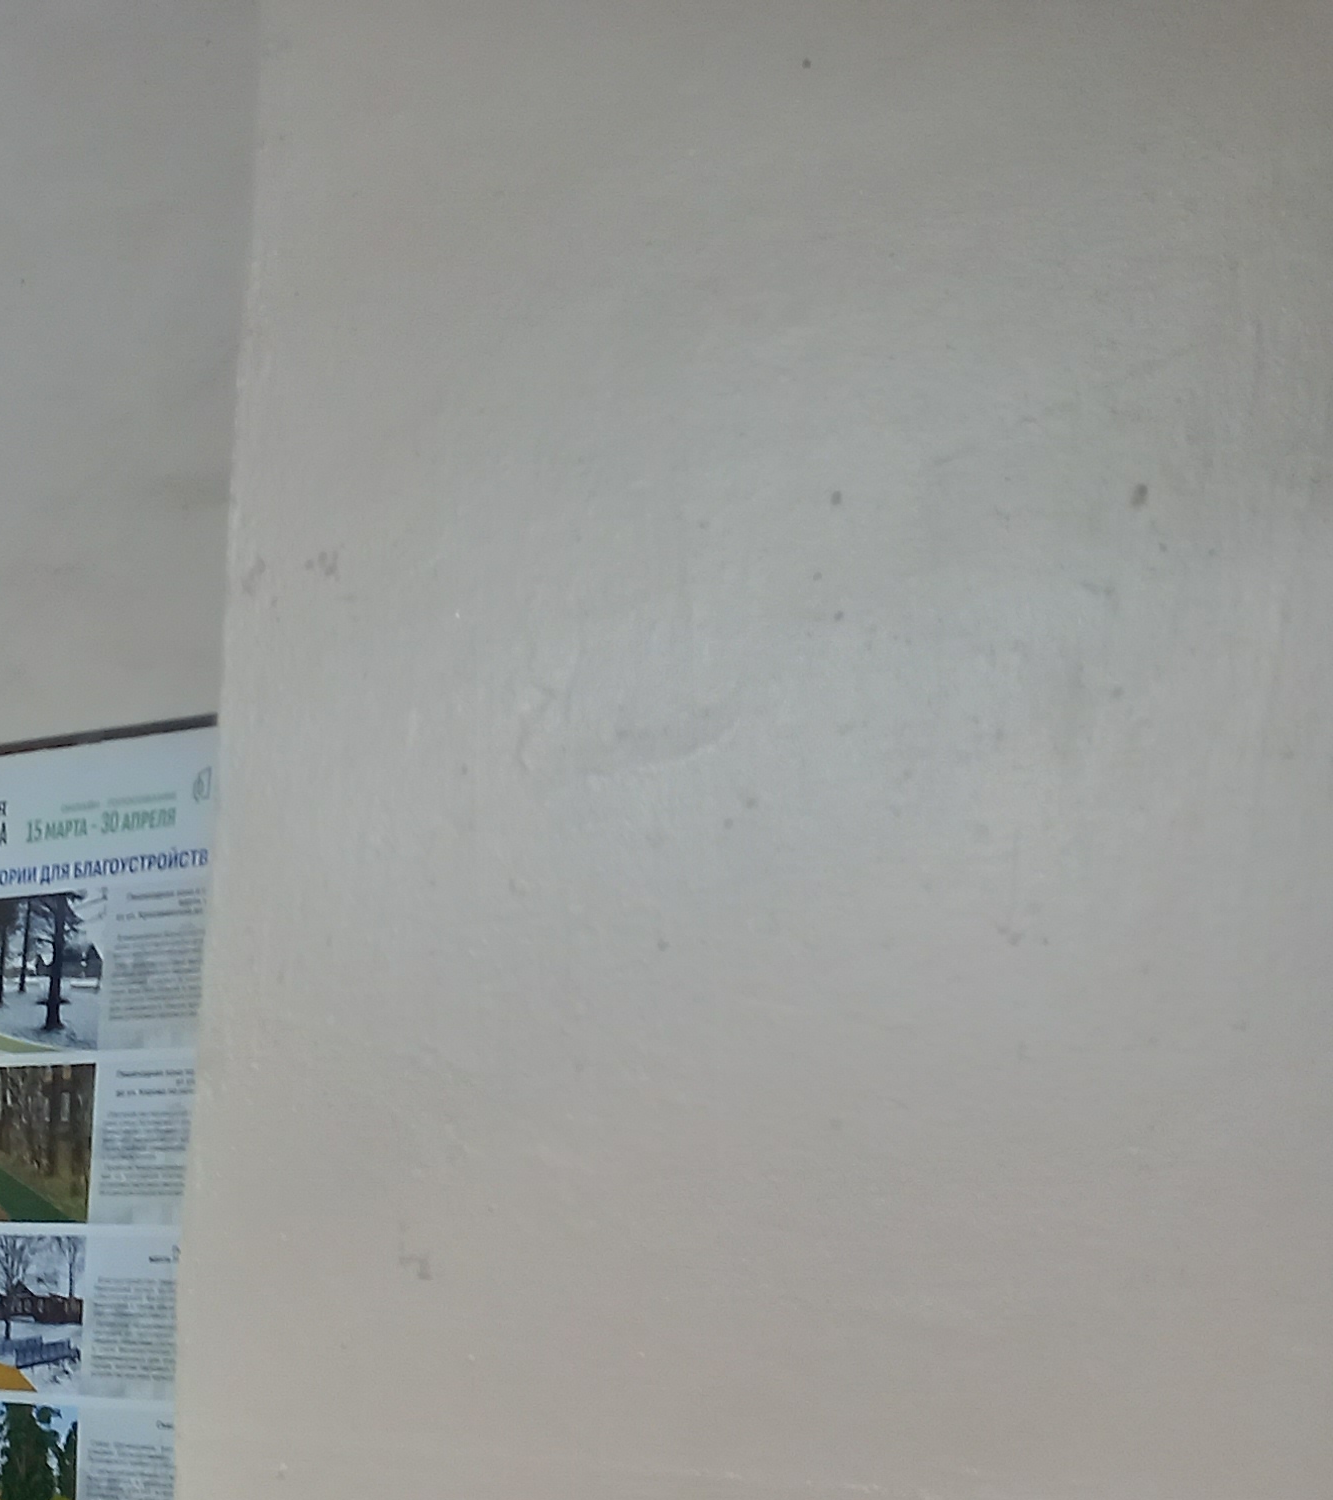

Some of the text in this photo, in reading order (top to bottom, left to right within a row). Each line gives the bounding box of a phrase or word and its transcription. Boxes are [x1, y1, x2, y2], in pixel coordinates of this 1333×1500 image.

[26, 818, 43, 844] 15
[44, 818, 88, 840] МАРТА
[101, 810, 119, 835] 30
[121, 807, 177, 832] АПРЕЛЯ
[39, 863, 70, 886] ДЛЯ
[73, 846, 209, 879] БЛАГОУСТРОЙСТВ
